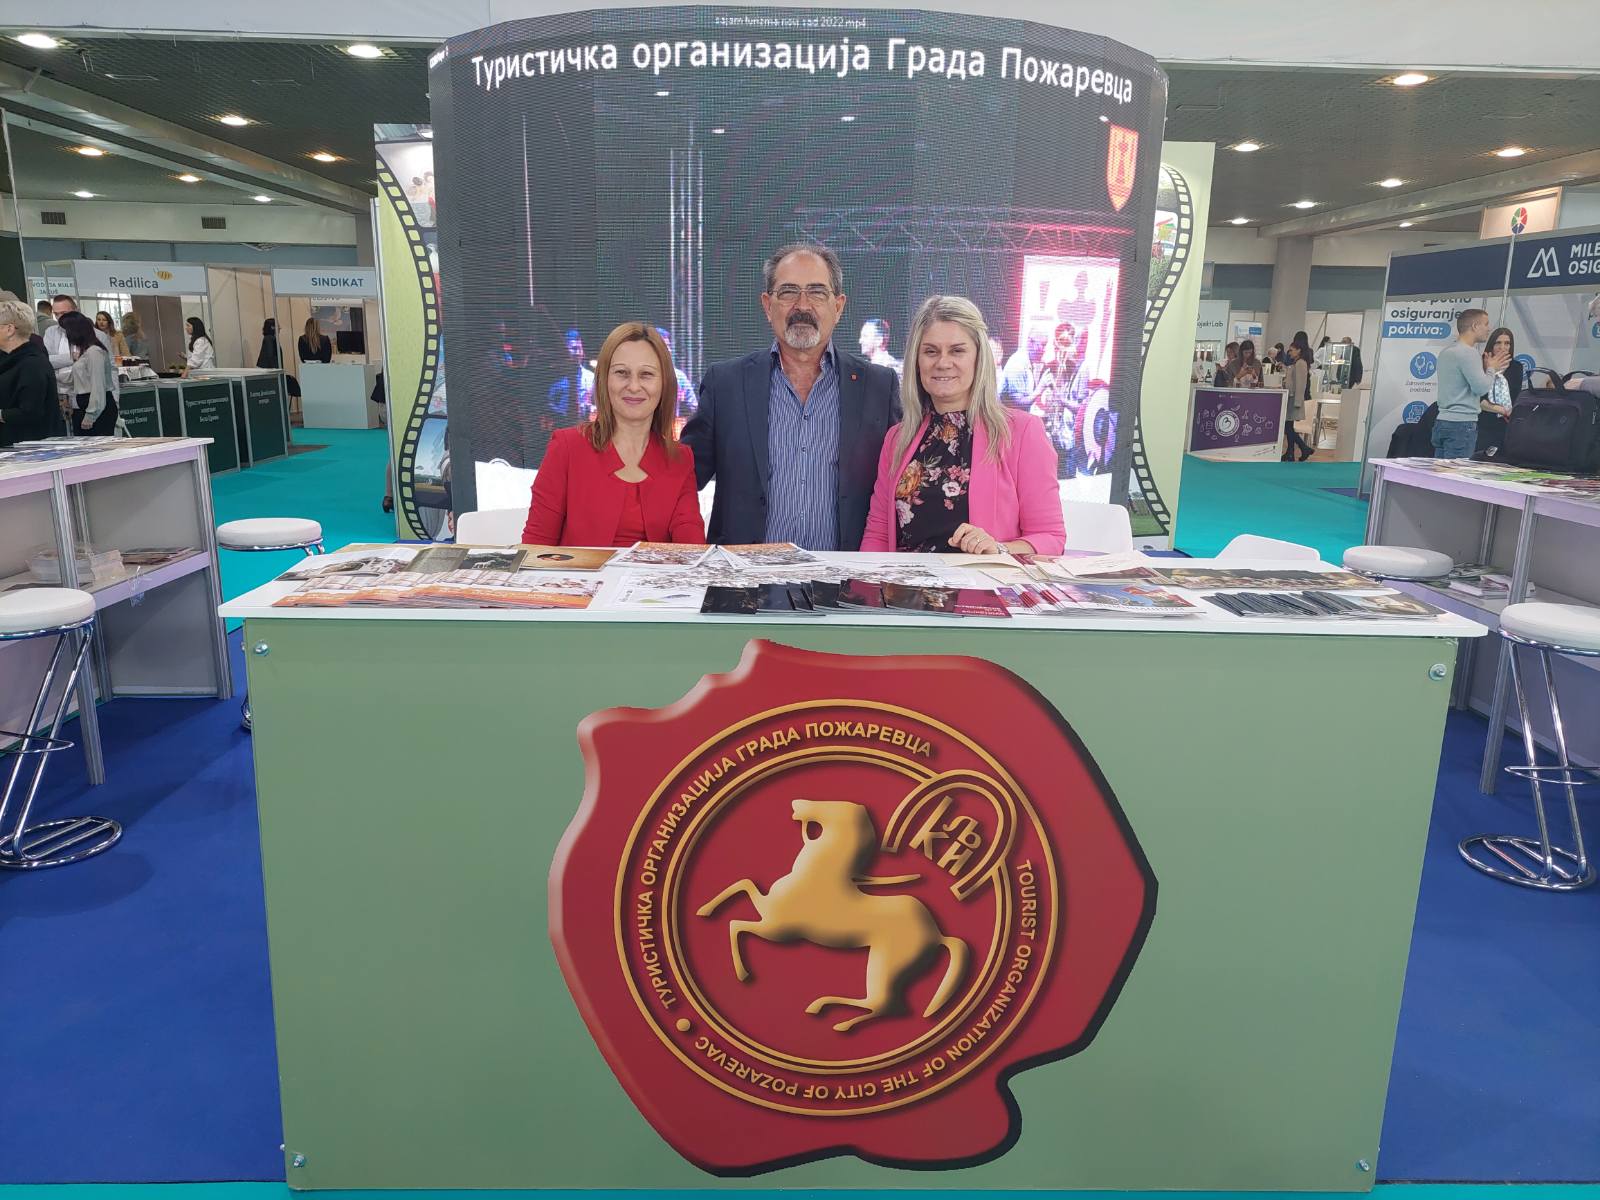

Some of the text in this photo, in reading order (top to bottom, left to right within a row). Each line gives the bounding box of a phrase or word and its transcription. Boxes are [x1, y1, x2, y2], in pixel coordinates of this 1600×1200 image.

[472, 42, 617, 91] Туристичка
[633, 38, 871, 77] организација
[887, 38, 986, 80] Града
[1001, 47, 1132, 103] Пожаревца
[109, 277, 159, 289] Radilica
[311, 277, 364, 287] SINDIKAT
[1390, 307, 1463, 322] osiguranje
[1388, 323, 1443, 337] pokriva:
[638, 721, 932, 1009] ТУРИСТИЧКА ОРГАНИЗАЦИЈА ГРАДА ПОЖАРЕВЦА
[694, 859, 1037, 1100] TOURIST ORGANIZATION OF THE CITY OF POZAREVAC
